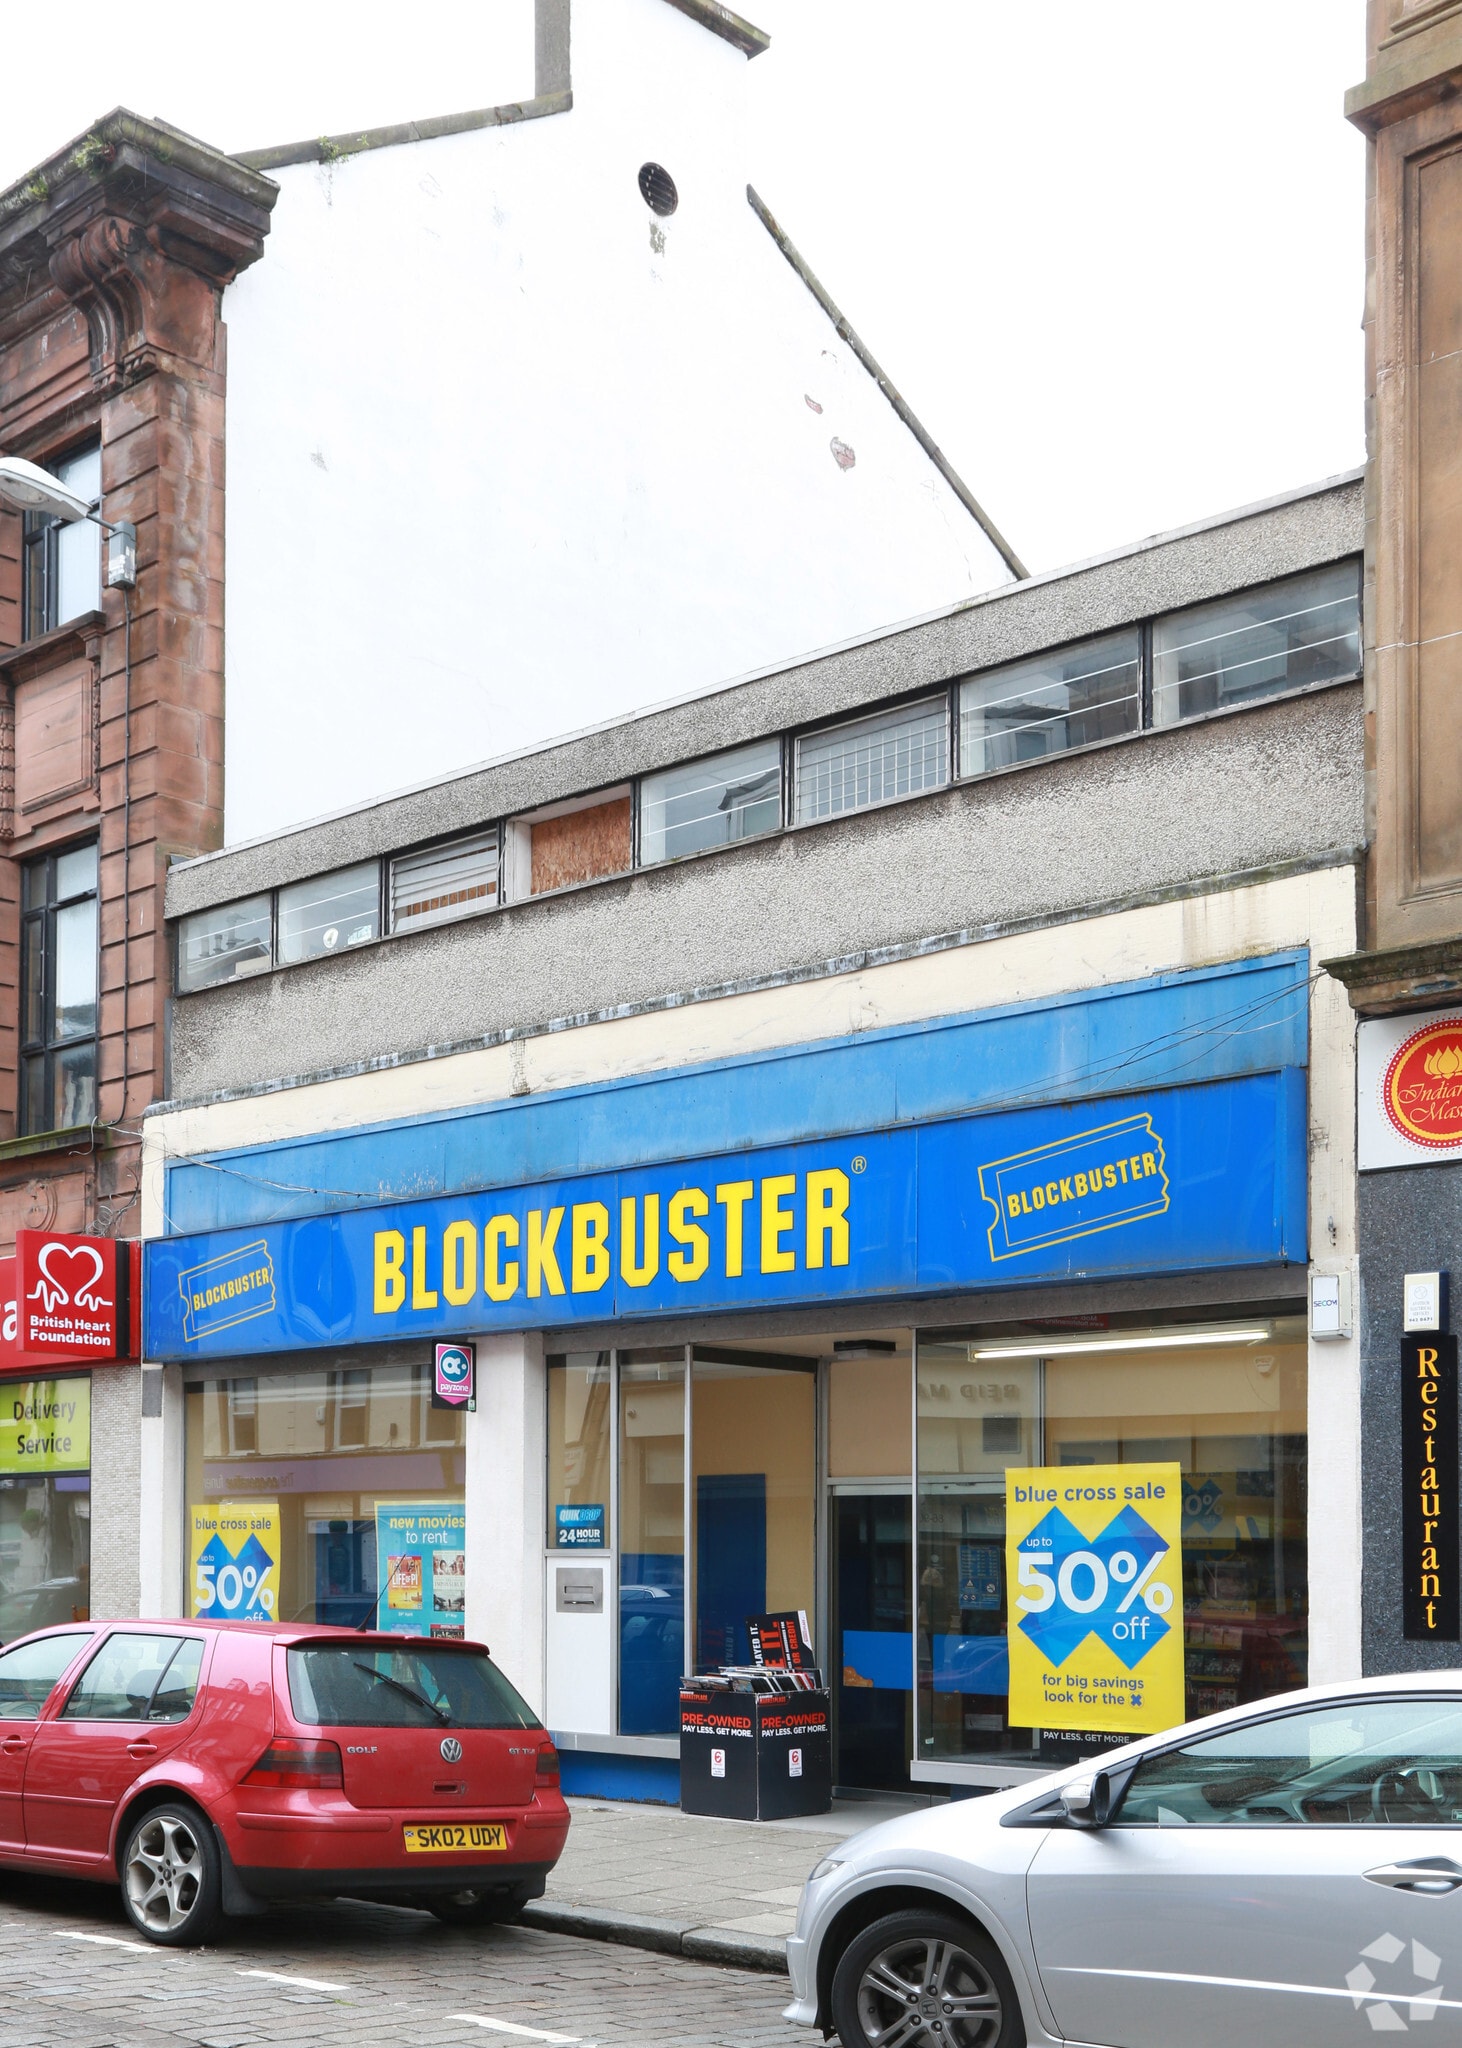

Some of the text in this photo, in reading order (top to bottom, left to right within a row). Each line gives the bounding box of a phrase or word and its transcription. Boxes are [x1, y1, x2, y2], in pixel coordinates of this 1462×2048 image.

[1410, 1100, 1462, 1123] Mas
[1007, 1152, 1157, 1218] BLOCKBUSTER
[193, 1267, 270, 1311] BLOCKBUSTER
[1313, 1299, 1338, 1307] SECOM
[30, 1315, 111, 1332] British Heart
[30, 1328, 111, 1346] Foundation
[440, 1383, 469, 1393] payzone
[14, 1399, 76, 1423] Delivery
[18, 1432, 72, 1454] Service
[1015, 1482, 1166, 1503] blue cross sale
[1417, 1348, 1441, 1630] Restaurant
[195, 1517, 272, 1530] blue cross sale
[390, 1513, 464, 1529] new movies
[405, 1531, 448, 1544] to rent
[559, 1529, 601, 1543] 24 HOUR
[1026, 1537, 1053, 1549] up to
[194, 1564, 275, 1611] 50%
[392, 1573, 406, 1585] LIFE
[411, 1573, 418, 1585] PI
[1014, 1550, 1174, 1615] 50%
[786, 1620, 798, 1649] CREDIT
[1112, 1616, 1150, 1640] off
[1042, 1673, 1144, 1691] for big savings
[1044, 1690, 1125, 1705] look for the
[681, 1712, 752, 1729] PRE-OWNED
[761, 1712, 826, 1729] PRE-OWNED
[682, 1724, 754, 1737] PAY LESS. GET MORE.
[761, 1724, 828, 1737] PAY LESS. GET MORE.
[1043, 1731, 1133, 1744] PAY LESS. GET MORE.
[346, 1746, 378, 1754] GOLF
[417, 1828, 501, 1847] SK02 UDY
